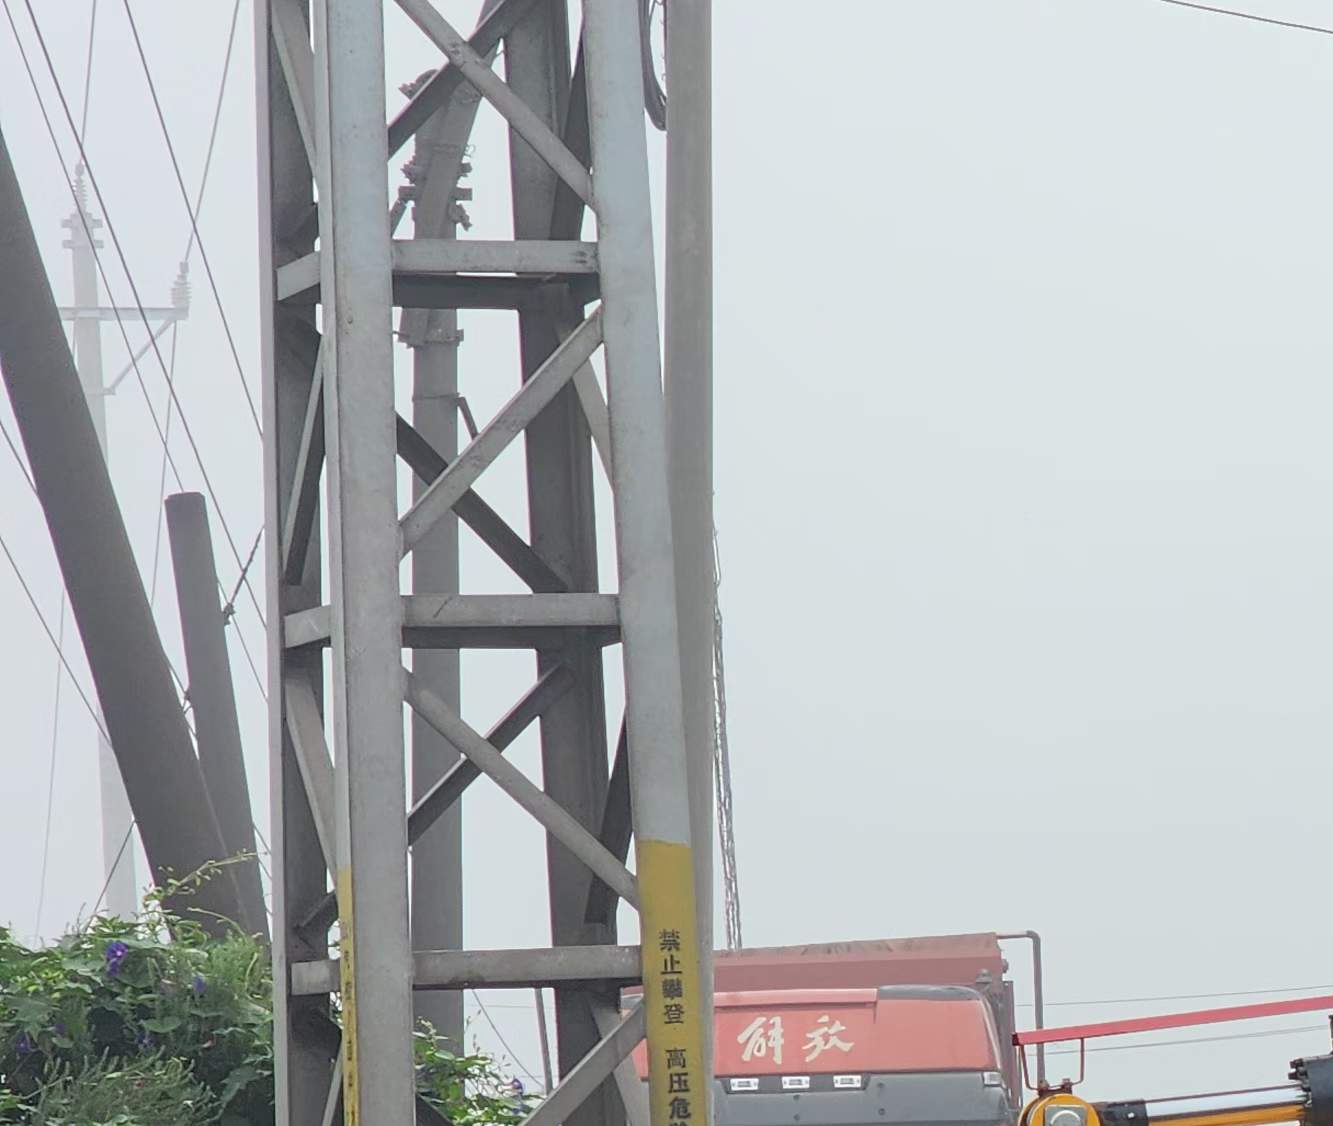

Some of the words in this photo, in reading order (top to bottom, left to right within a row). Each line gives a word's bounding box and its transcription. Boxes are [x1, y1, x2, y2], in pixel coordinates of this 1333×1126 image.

[659, 929, 685, 1025] 禁止攀登
[737, 1015, 855, 1065] 解放
